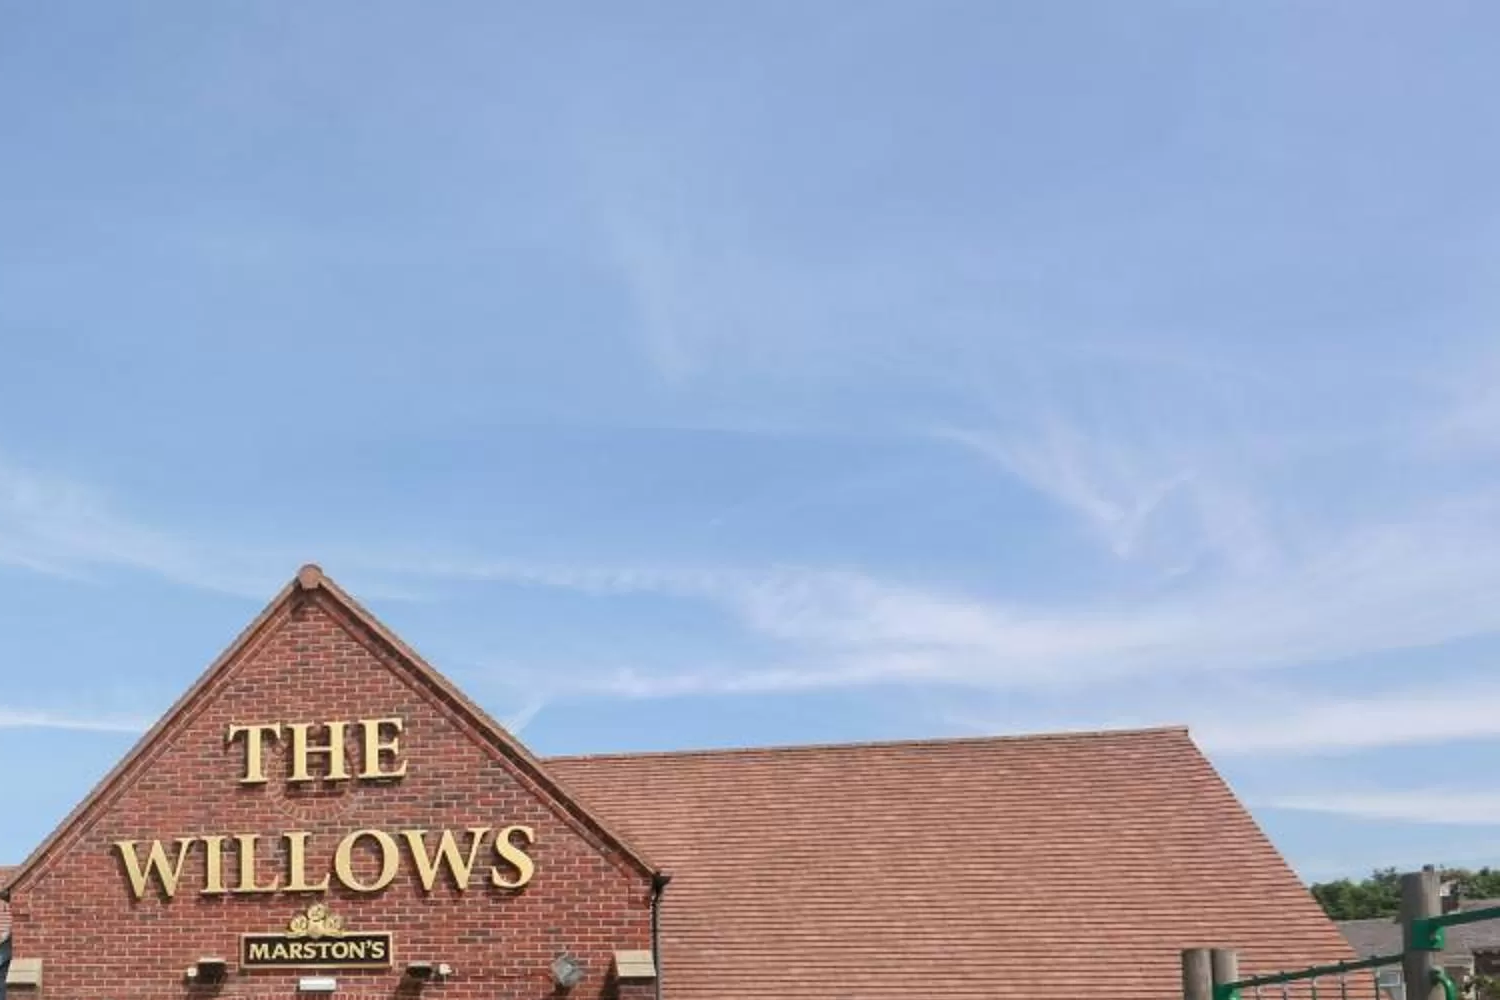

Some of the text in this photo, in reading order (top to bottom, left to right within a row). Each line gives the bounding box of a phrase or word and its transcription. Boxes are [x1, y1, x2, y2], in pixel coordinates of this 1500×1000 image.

[228, 717, 408, 784] THE
[114, 825, 536, 898] WILLOWS
[249, 940, 385, 960] MARSTON'S
